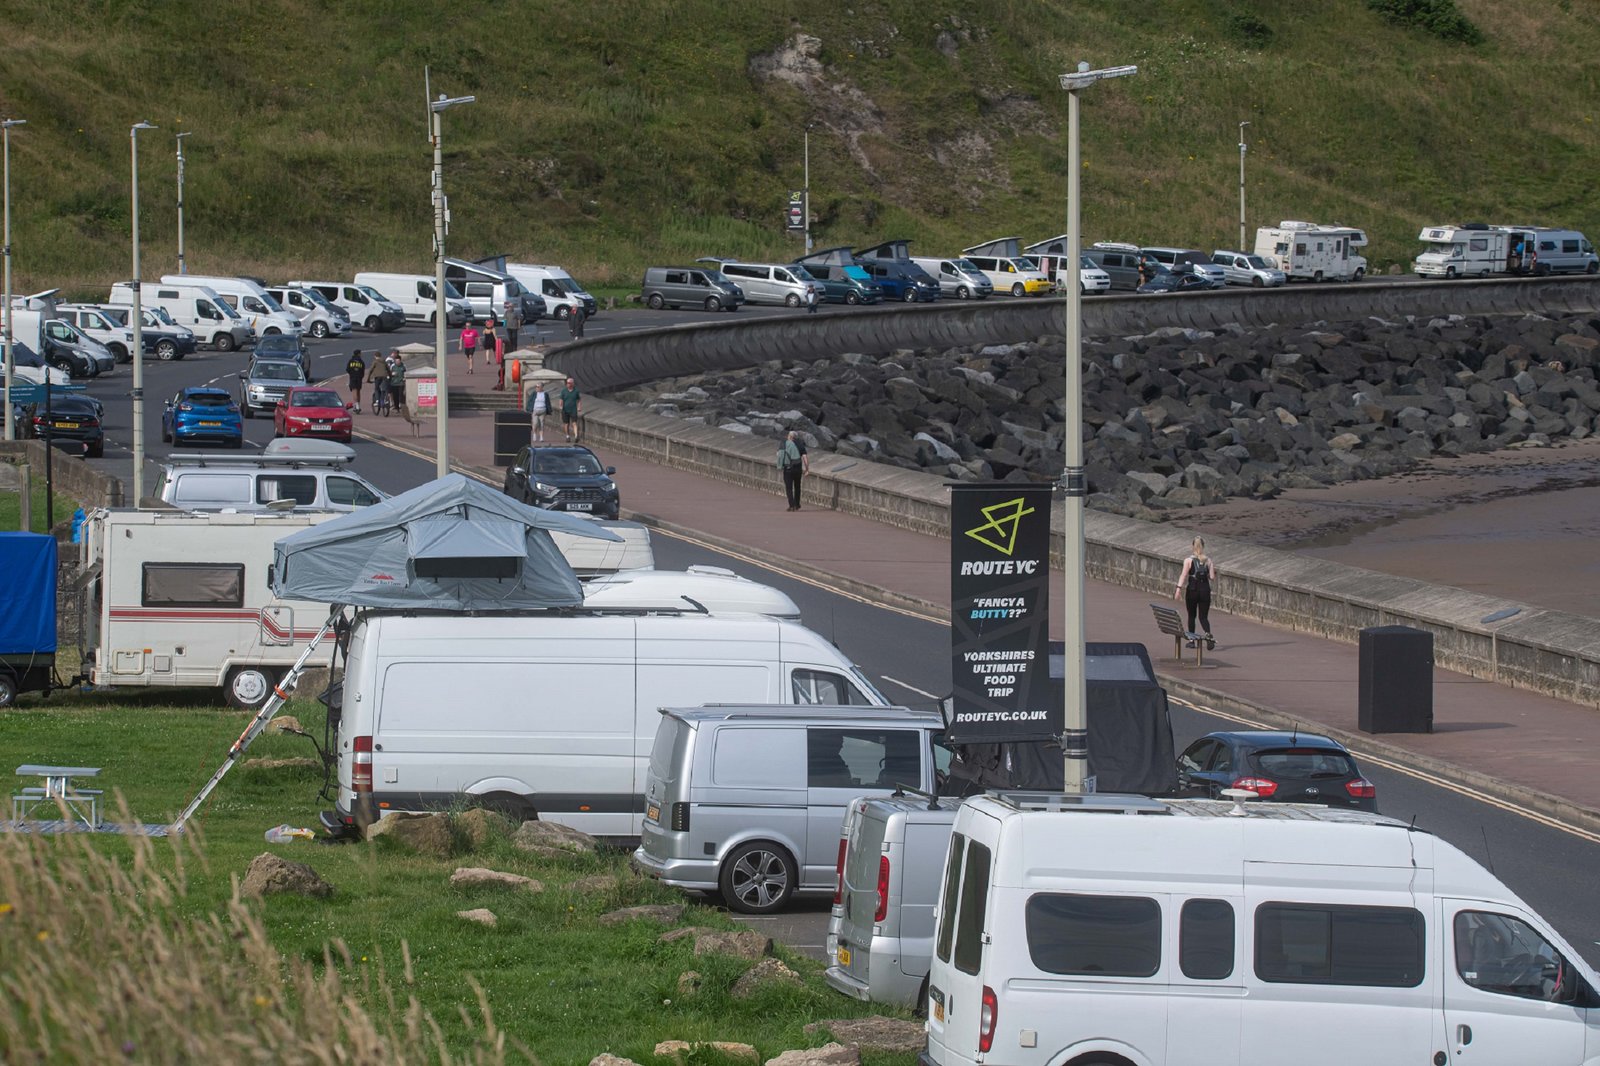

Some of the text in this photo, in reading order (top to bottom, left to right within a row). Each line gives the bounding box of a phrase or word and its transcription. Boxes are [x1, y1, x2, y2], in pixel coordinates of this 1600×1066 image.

[960, 560, 1037, 576] ROUTE YC
[1016, 597, 1025, 607] A
[963, 650, 1036, 662] YORKSHIRES
[972, 663, 1027, 674] ULTIMATE
[983, 675, 1016, 685] FOOD
[987, 687, 1014, 697] TRIP
[956, 710, 1048, 723] ROUTEYC.CO.UK
